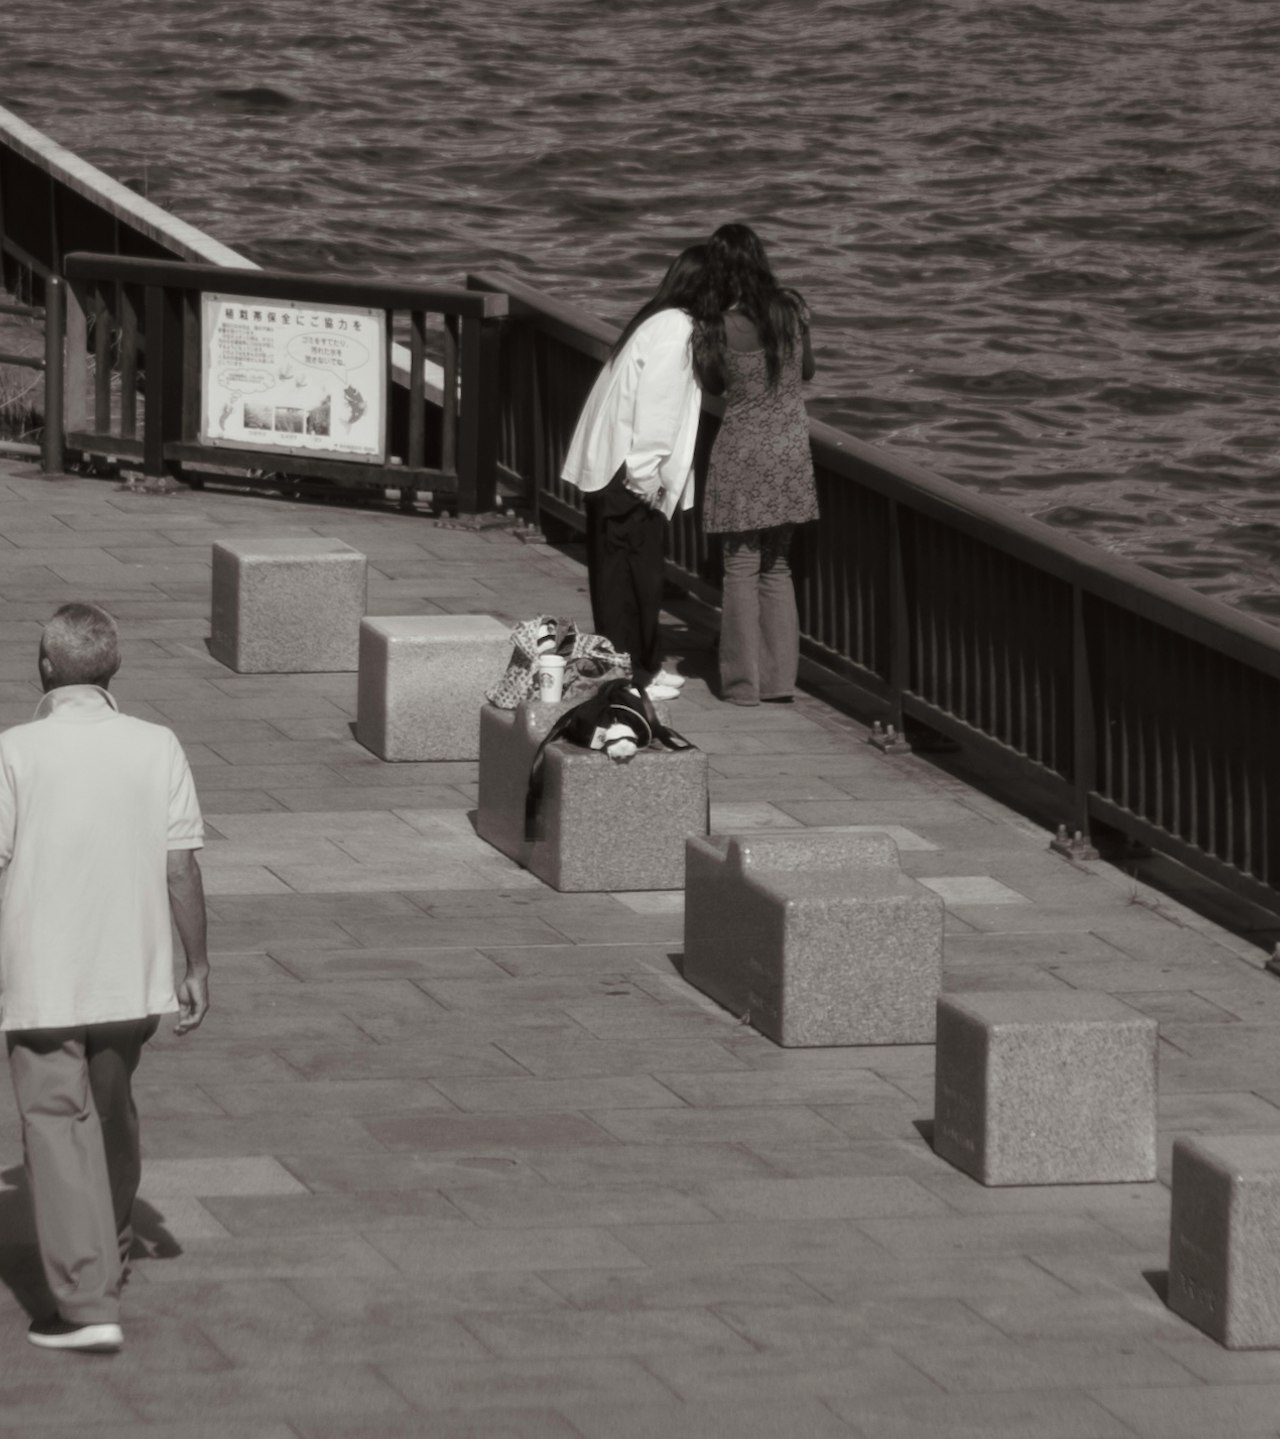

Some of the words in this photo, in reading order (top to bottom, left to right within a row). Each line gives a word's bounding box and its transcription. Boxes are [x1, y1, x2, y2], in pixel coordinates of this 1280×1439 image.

[225, 308, 362, 331] 植栽帯保全にご協力を
